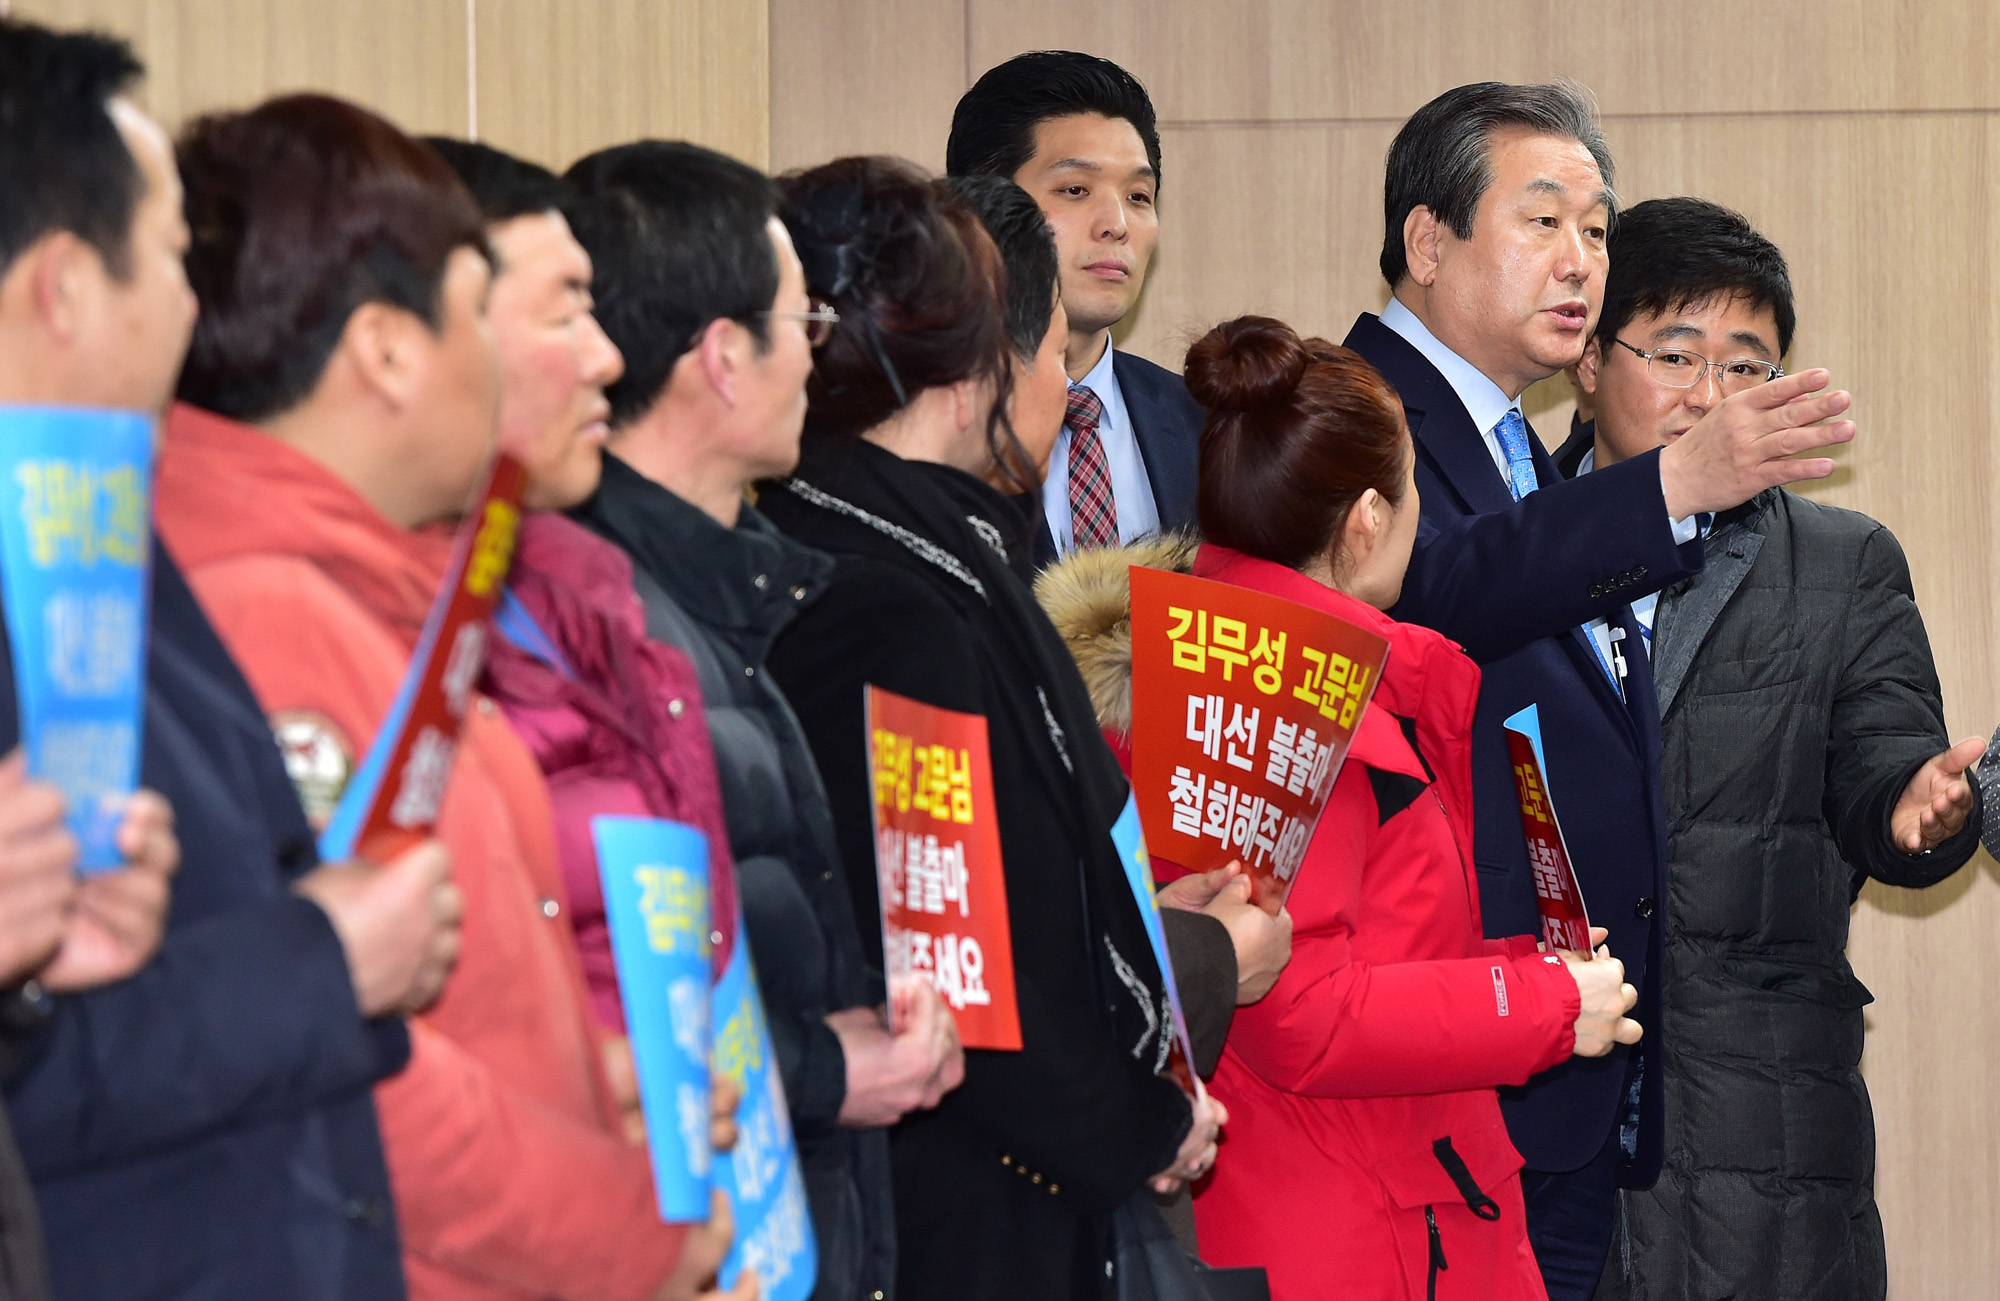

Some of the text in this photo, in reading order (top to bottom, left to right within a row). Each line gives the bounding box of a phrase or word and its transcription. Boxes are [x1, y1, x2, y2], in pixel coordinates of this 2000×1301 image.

[1166, 605, 1370, 730] 김무성 고문님
[914, 743, 974, 825] 고문님
[1186, 694, 1335, 806] 대선 불출마
[1514, 762, 1555, 827] 고문
[1167, 765, 1306, 882] 철회해주세요
[906, 832, 970, 918] 불출마
